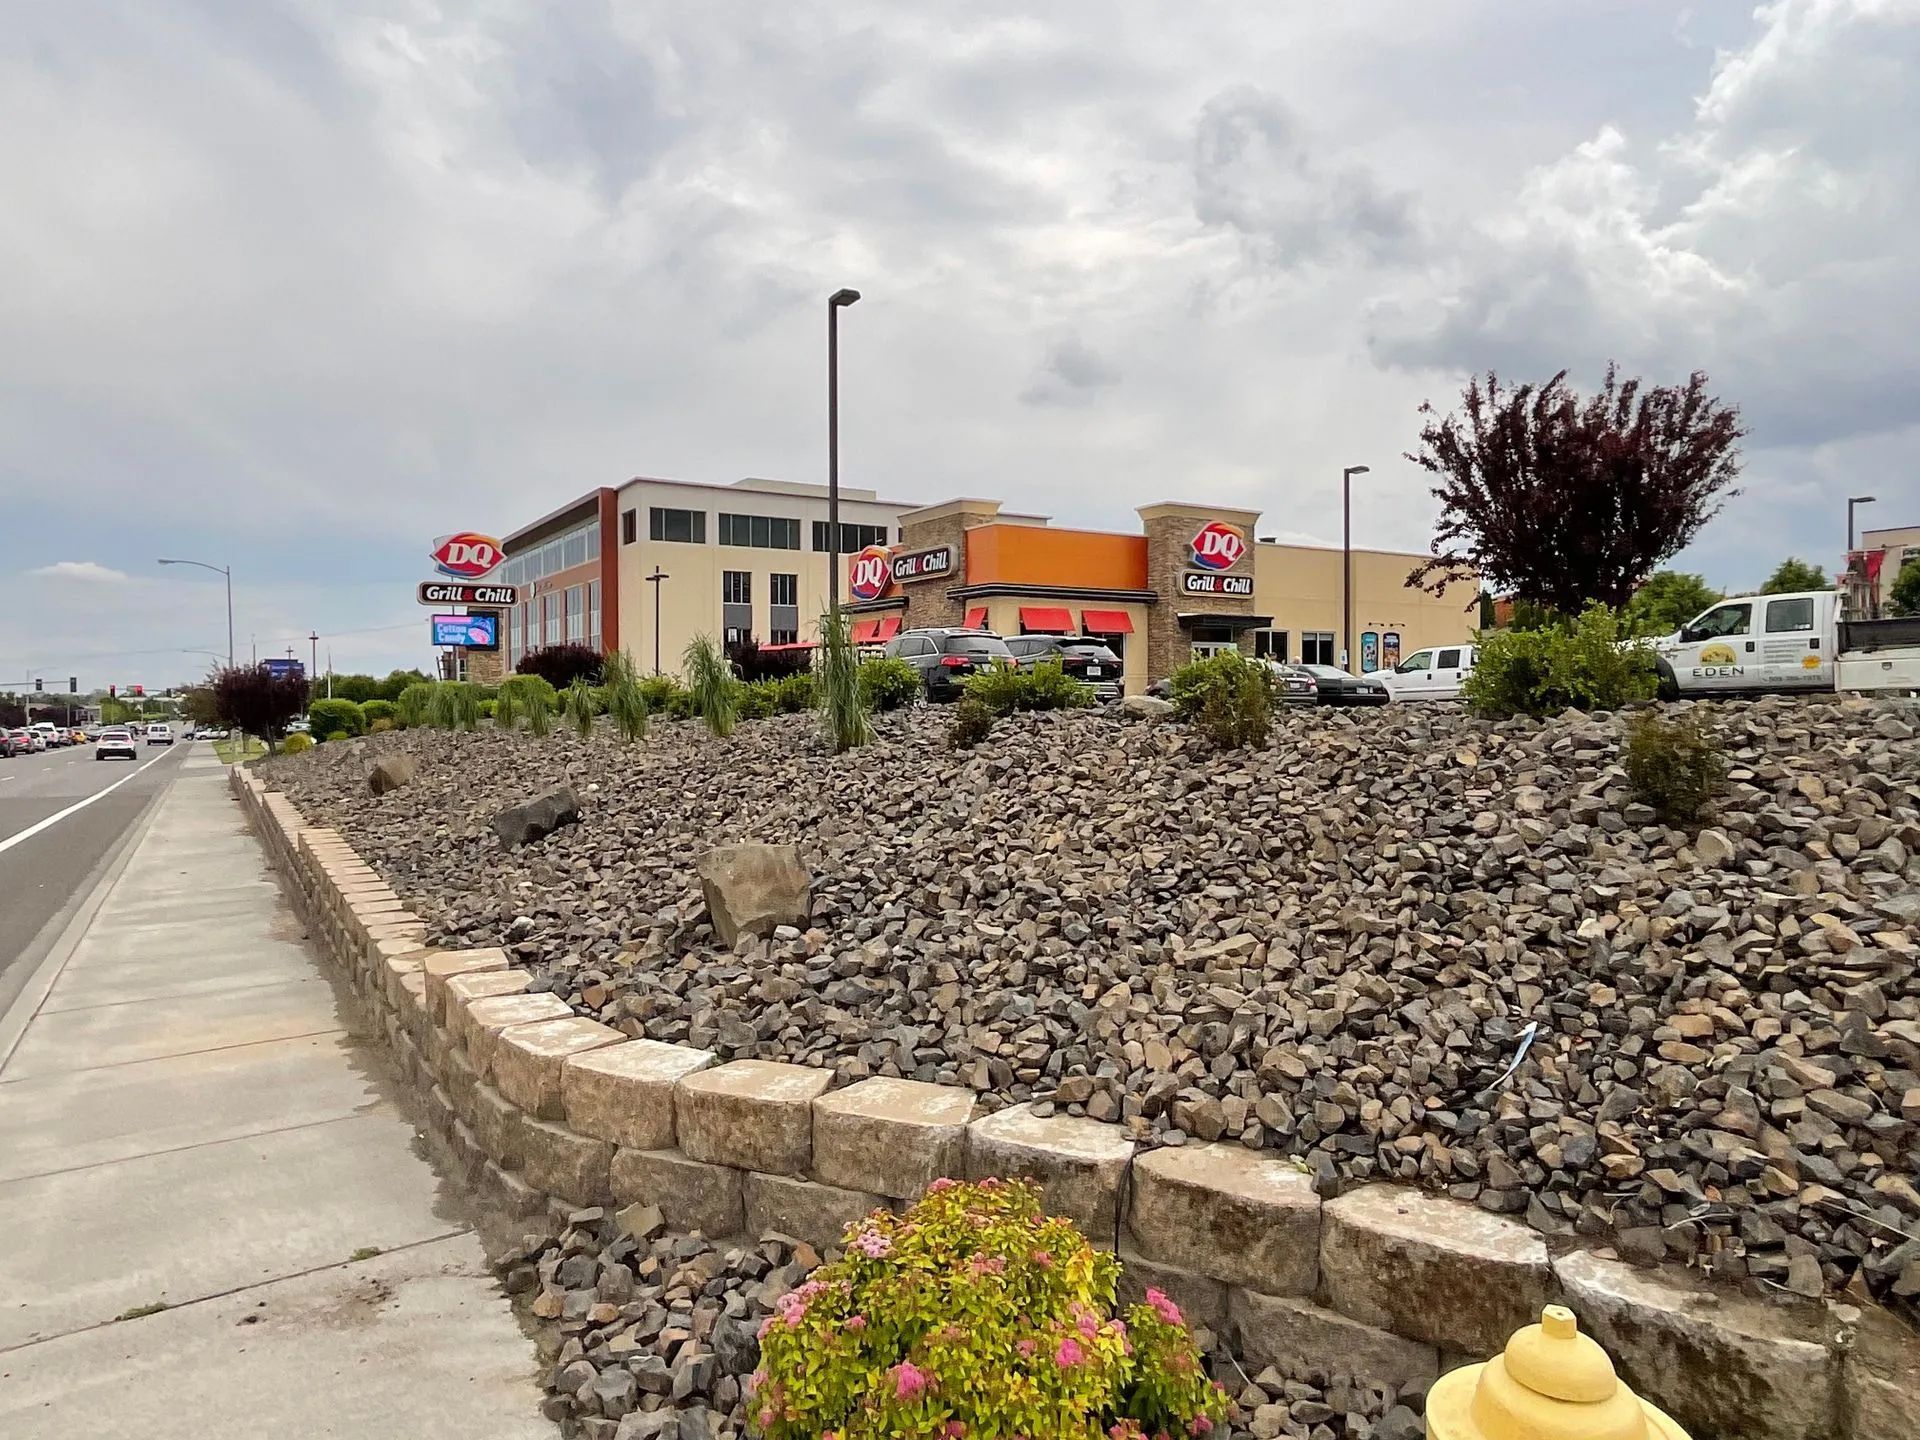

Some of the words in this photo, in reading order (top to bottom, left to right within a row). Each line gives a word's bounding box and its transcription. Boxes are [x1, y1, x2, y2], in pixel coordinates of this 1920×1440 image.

[447, 543, 493, 568] DQ
[1200, 530, 1240, 561] DQ
[855, 557, 882, 587] DQ
[895, 557, 916, 576] Grill
[922, 551, 947, 571] Chill
[426, 586, 463, 601] Grill
[474, 587, 512, 603] Chill
[1187, 575, 1215, 592] Grill
[1214, 577, 1223, 592] &
[1223, 578, 1250, 594] Chill
[438, 632, 465, 645] Candy
[1692, 666, 1745, 677] EDEN
